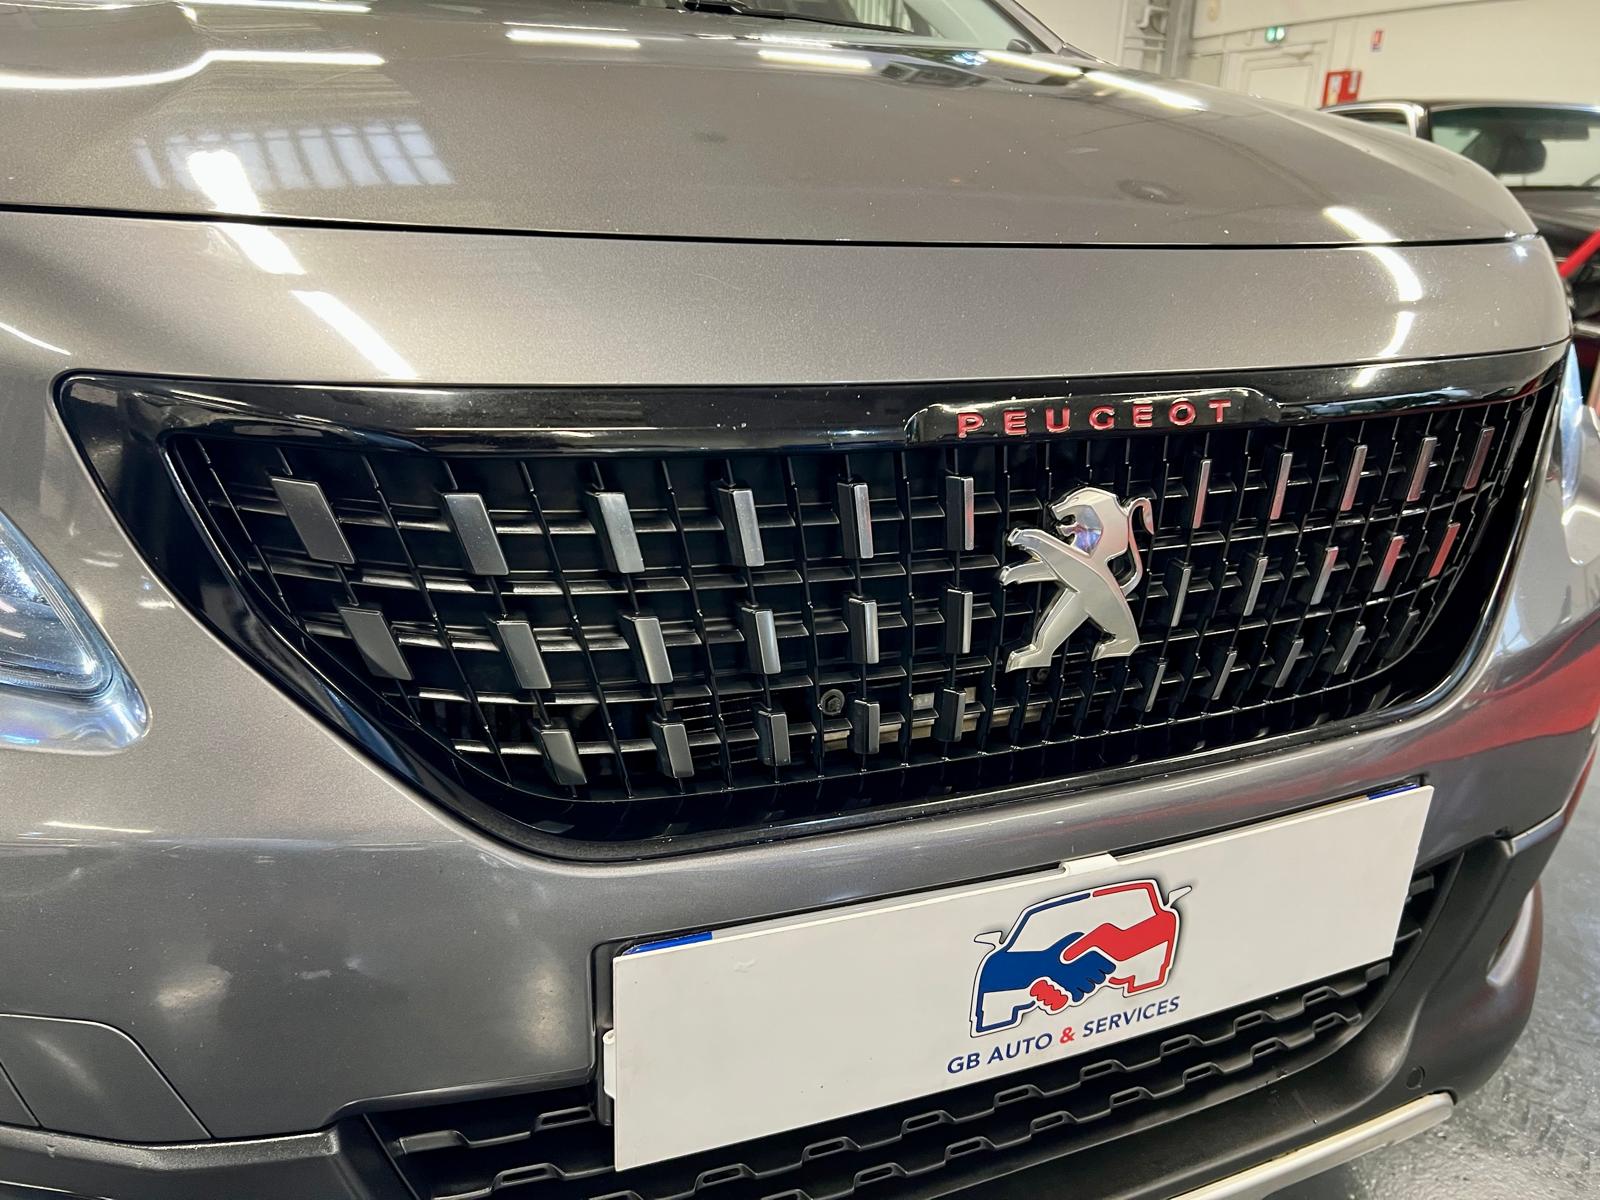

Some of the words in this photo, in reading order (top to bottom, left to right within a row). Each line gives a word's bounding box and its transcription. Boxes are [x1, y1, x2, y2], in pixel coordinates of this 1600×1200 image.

[955, 399, 1232, 439] PEUGEOT
[947, 1052, 980, 1074] GB
[987, 1032, 1053, 1065] AUTO
[1059, 1026, 1075, 1044] &
[1082, 996, 1181, 1038] SERVICES
